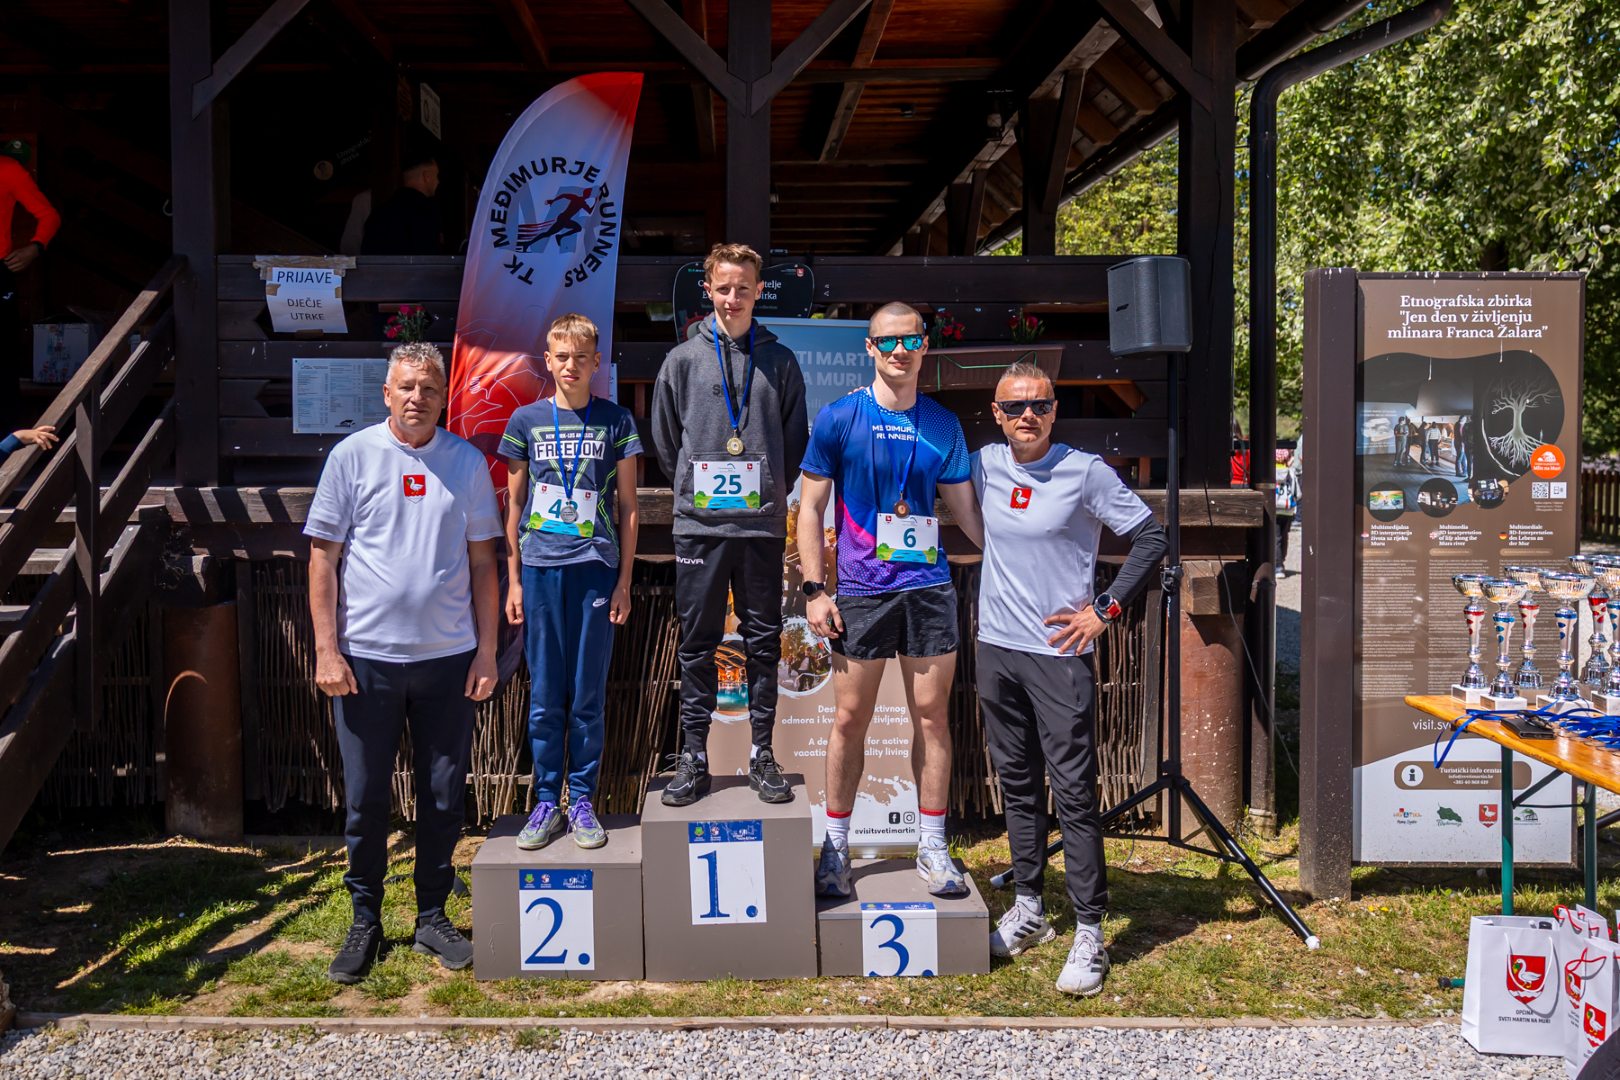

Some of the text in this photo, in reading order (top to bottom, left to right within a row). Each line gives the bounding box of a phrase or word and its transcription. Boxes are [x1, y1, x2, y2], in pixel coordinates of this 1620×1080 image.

[490, 156, 617, 288] TK MEĐIMURJE RUNNERS
[276, 271, 333, 284] PRIJAVE
[287, 297, 322, 308] DJEČJE
[1400, 295, 1533, 309] Etnografska zbirka
[290, 312, 325, 321] UTRKE
[1400, 310, 1533, 325] "Jen den v življenju
[1387, 326, 1443, 339] mlinara
[1446, 327, 1494, 339] Franca
[816, 372, 862, 386] MURI
[713, 474, 742, 495] 25
[904, 527, 917, 548] 6
[782, 717, 815, 725] odmora
[867, 736, 880, 745] for
[794, 749, 827, 757] vacatio
[885, 747, 909, 758] living
[697, 850, 758, 918] 1.
[525, 897, 590, 964] 2.
[868, 914, 934, 976] 3.
